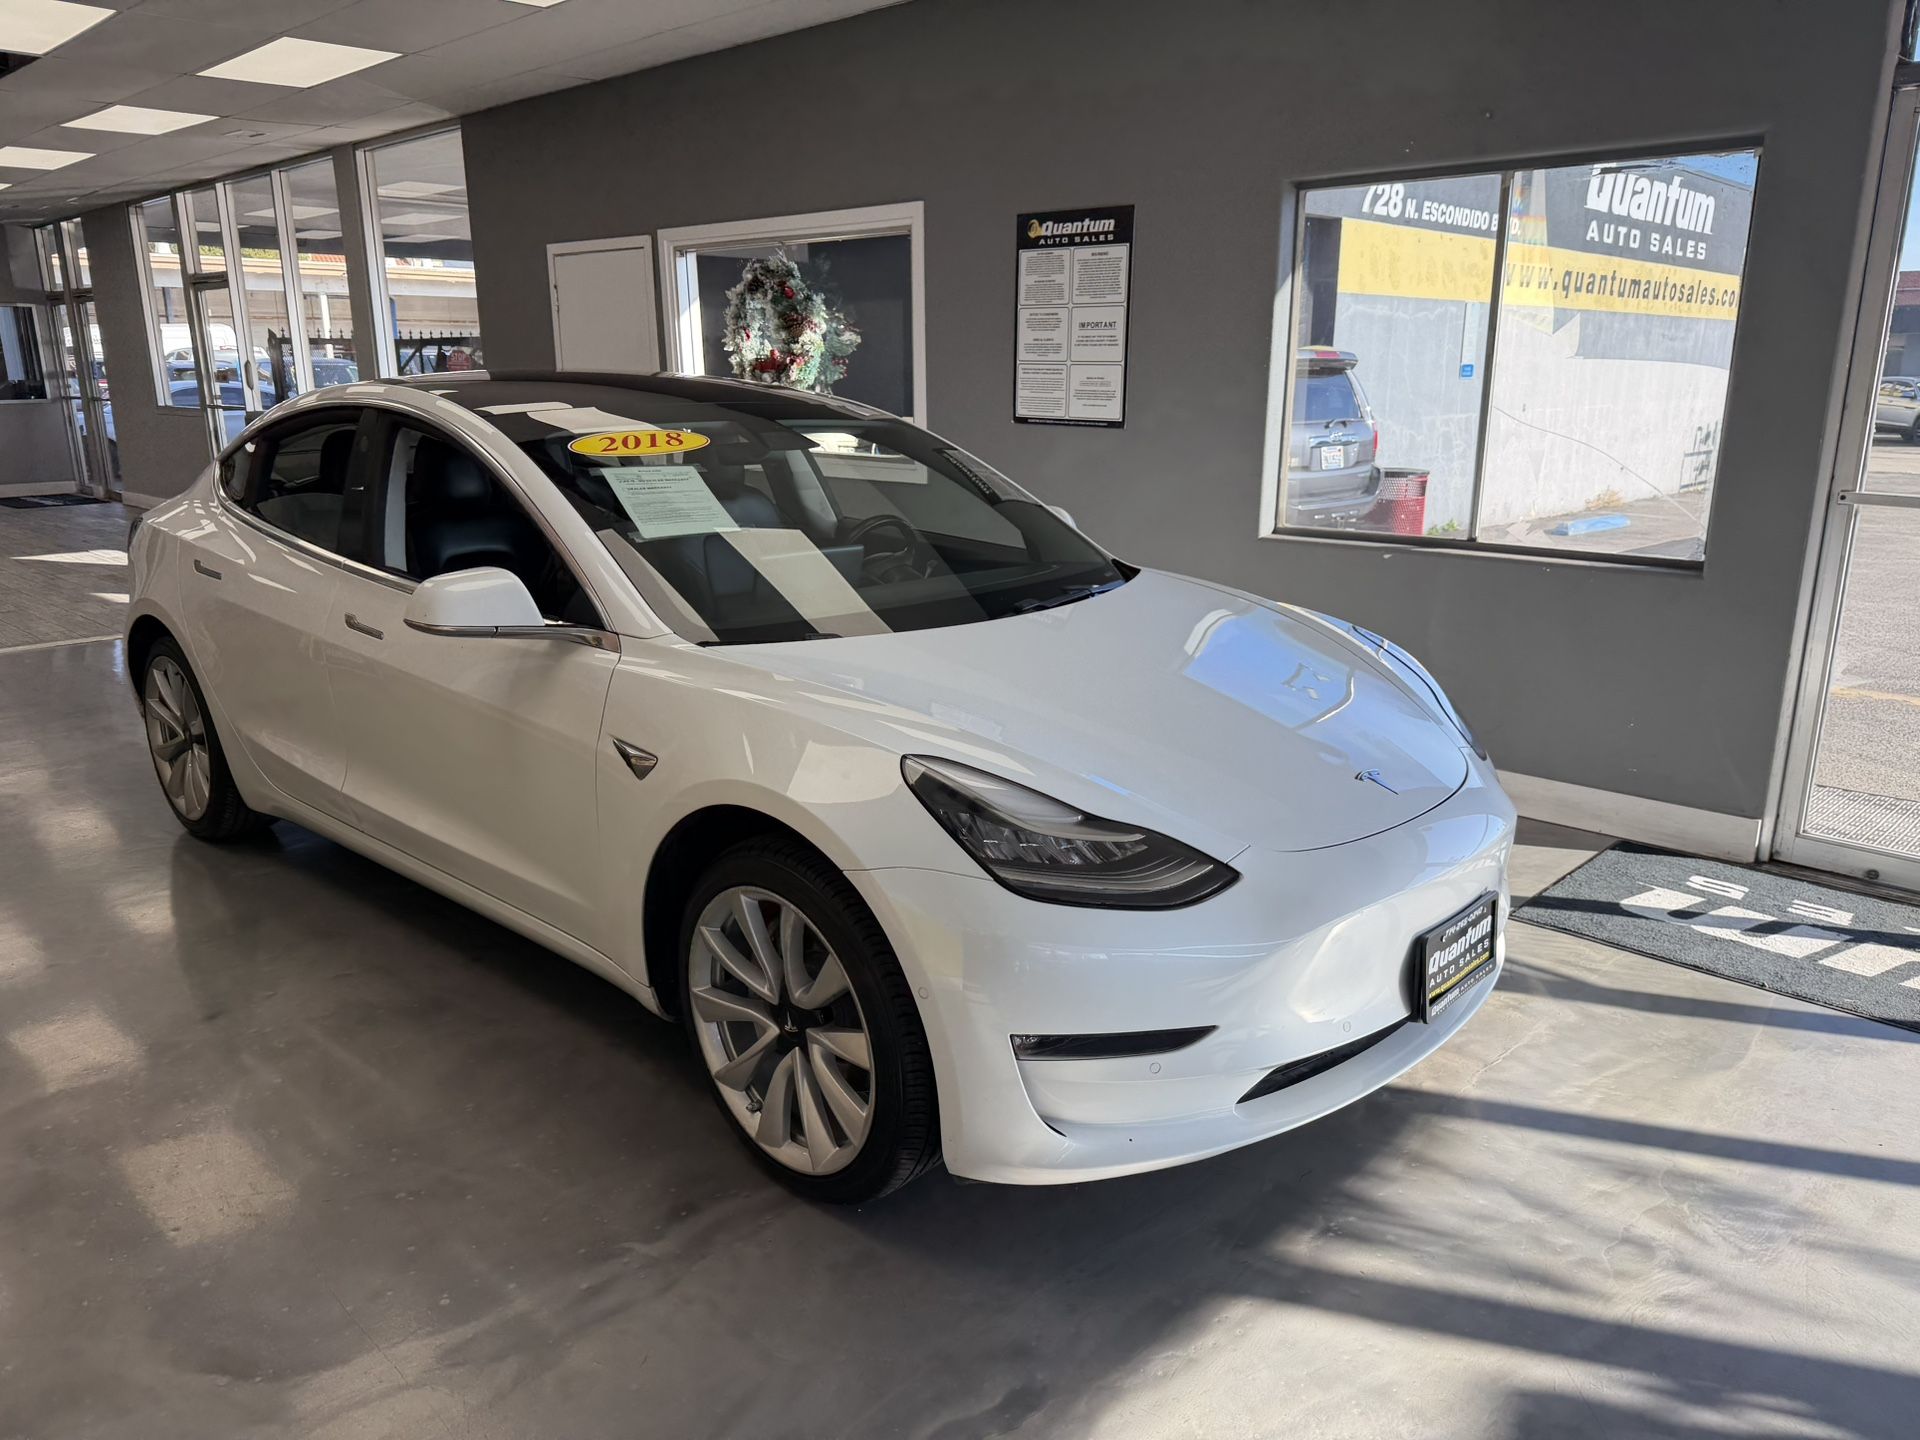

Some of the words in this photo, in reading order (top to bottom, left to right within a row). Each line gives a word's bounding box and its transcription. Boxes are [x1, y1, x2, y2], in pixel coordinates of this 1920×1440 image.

[1362, 183, 1405, 218] 728
[1405, 199, 1419, 220] N.
[1421, 201, 1489, 231] ESCONDIDO
[1491, 212, 1521, 236] BD.
[1584, 163, 1716, 235] Quantum
[1038, 236, 1069, 245] AUTO
[1074, 234, 1114, 243] SALES
[1041, 218, 1116, 236] Quantum
[1586, 220, 1641, 249] AUTO
[1649, 233, 1707, 260] SALES
[1505, 262, 1738, 309] www.quantumautosales.co
[1079, 321, 1117, 329] IMPORTANT
[450, 352, 467, 361] STOP
[599, 431, 685, 453] 2018
[1428, 914, 1492, 975] Quantum
[1429, 965, 1455, 989] AUTO
[1459, 938, 1490, 967] SALES
